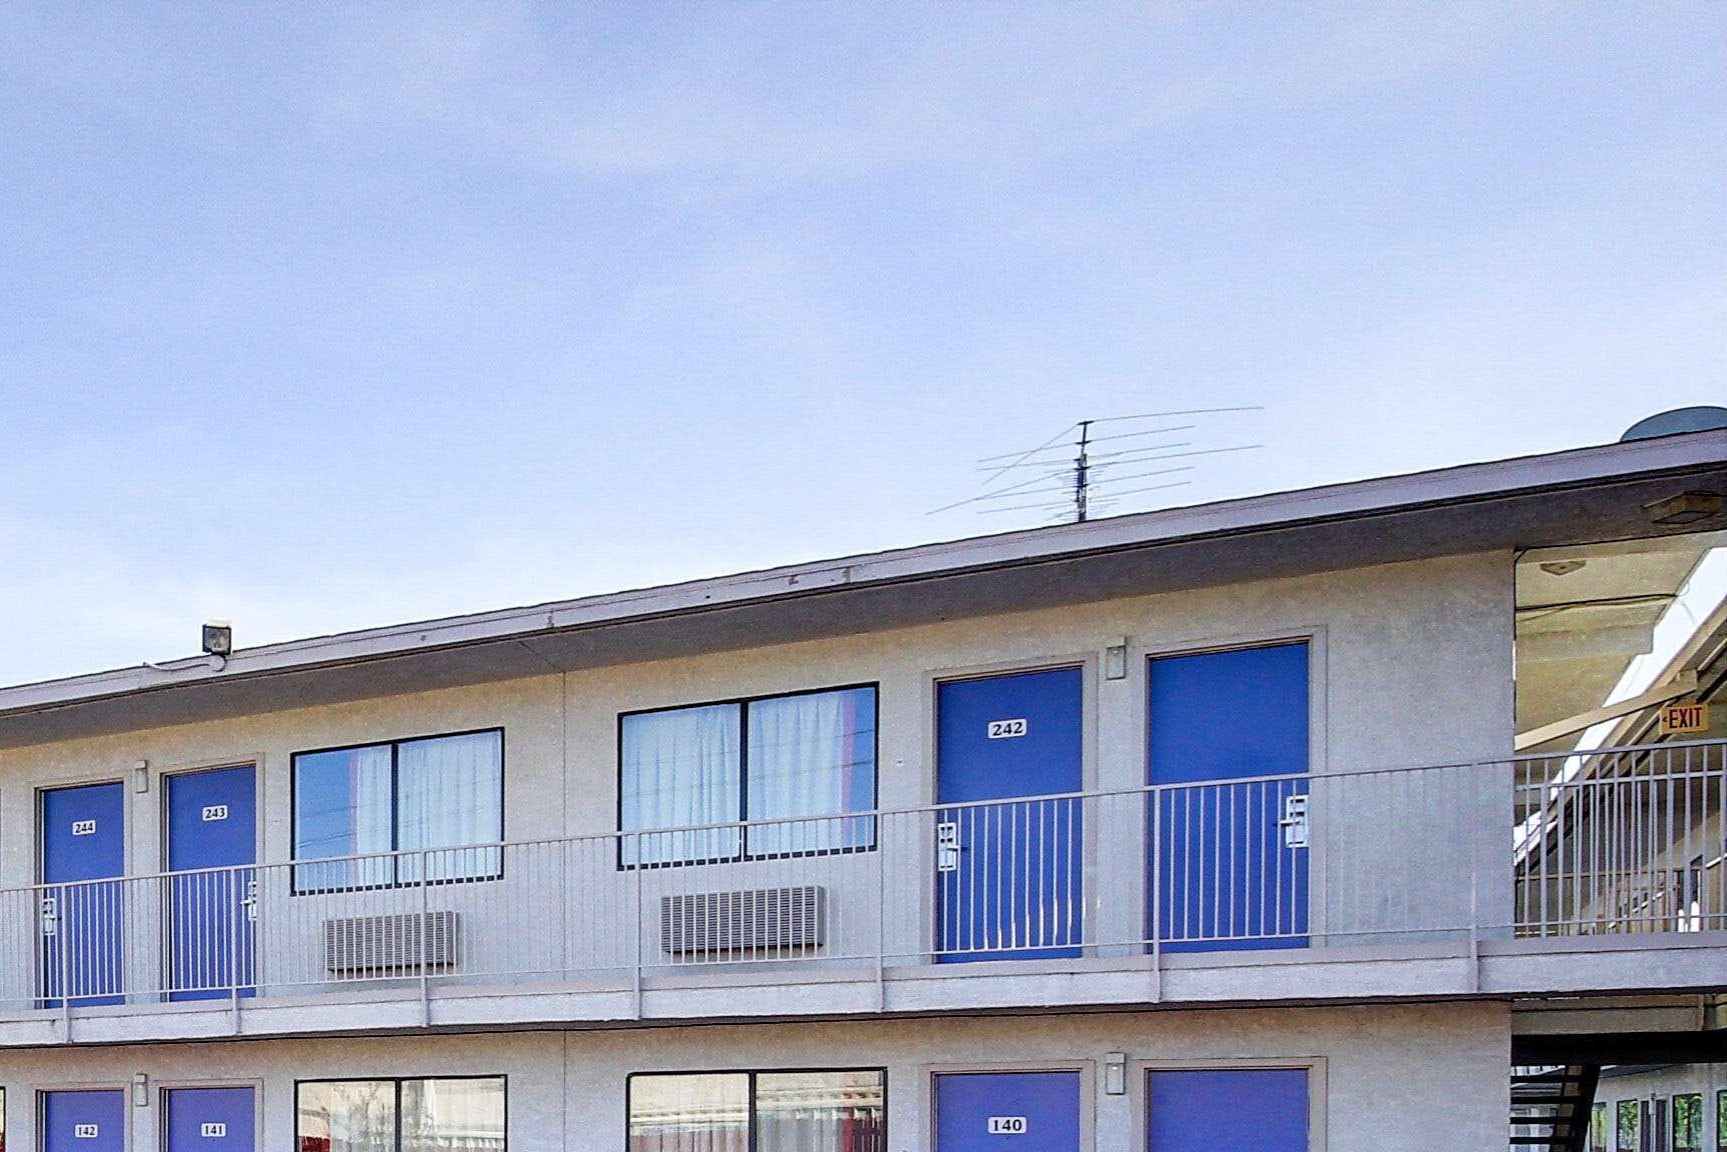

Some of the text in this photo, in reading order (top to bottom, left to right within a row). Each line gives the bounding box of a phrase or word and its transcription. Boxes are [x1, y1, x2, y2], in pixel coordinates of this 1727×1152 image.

[1668, 707, 1703, 729] EXIT
[992, 721, 1023, 736] 242
[205, 807, 225, 819] 243
[75, 822, 93, 833] 244
[78, 1126, 95, 1136] 142
[205, 1125, 222, 1135] 141
[993, 1119, 1022, 1131] 140
